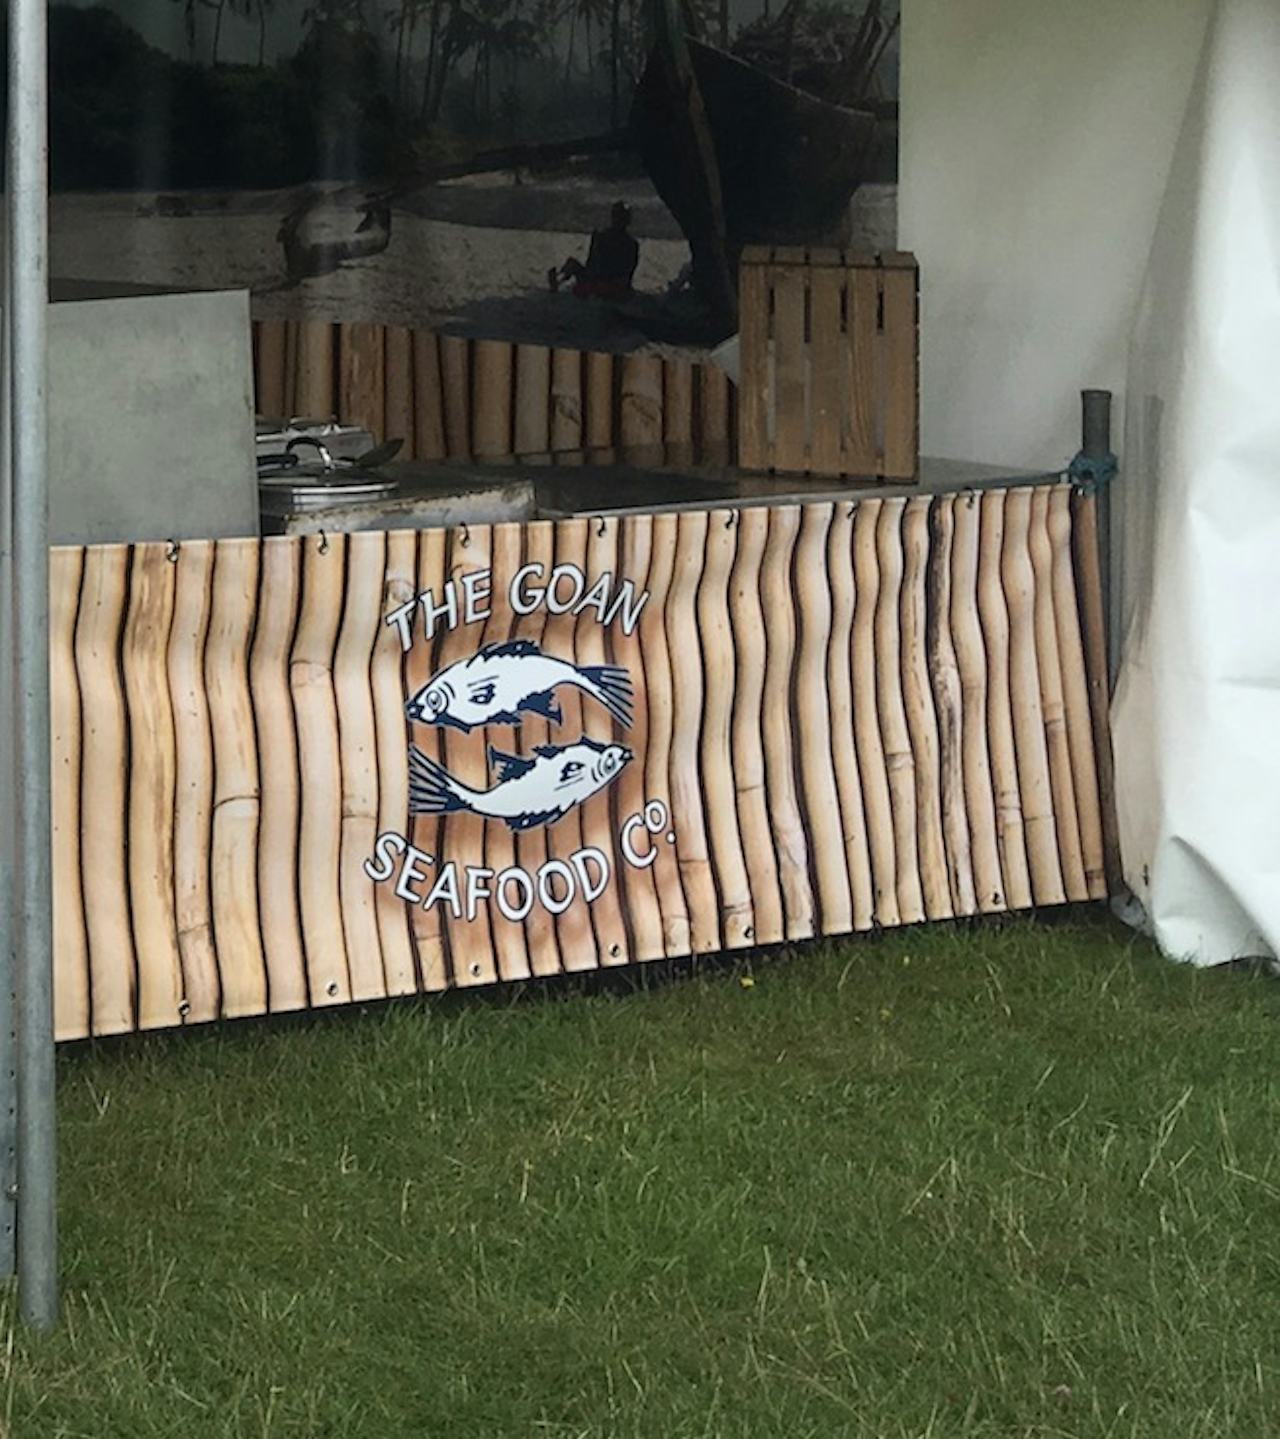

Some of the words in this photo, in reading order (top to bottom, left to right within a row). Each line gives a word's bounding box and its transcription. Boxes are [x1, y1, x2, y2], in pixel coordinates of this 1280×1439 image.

[387, 570, 492, 651] THE
[509, 563, 650, 636] GOAN
[363, 831, 610, 922] SEAFOOD
